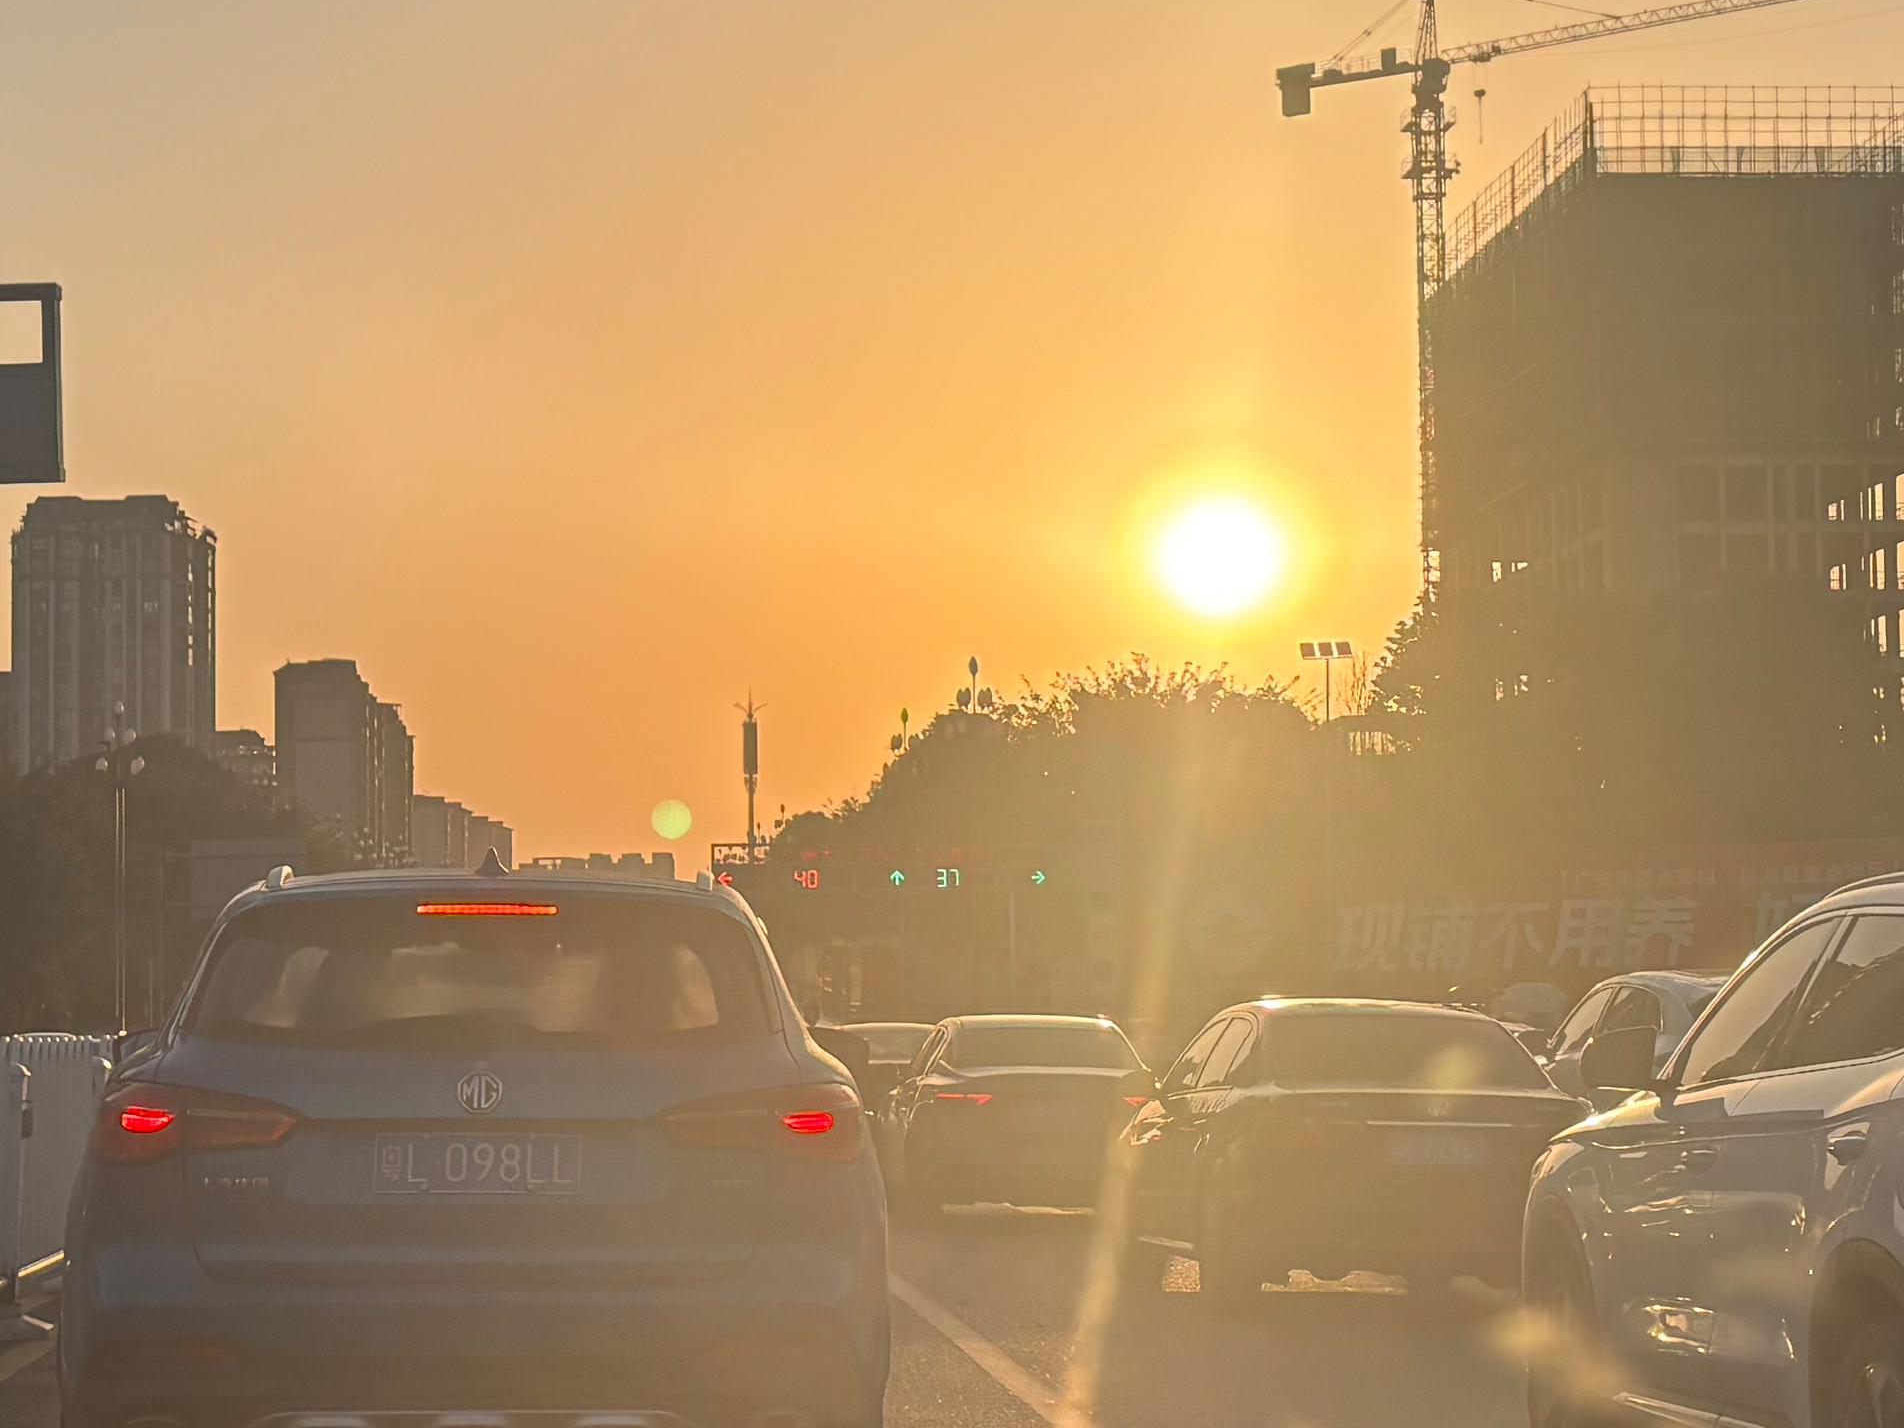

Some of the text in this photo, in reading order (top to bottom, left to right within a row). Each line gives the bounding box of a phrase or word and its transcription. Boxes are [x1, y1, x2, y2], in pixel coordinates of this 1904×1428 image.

[794, 869, 819, 888] 40
[936, 868, 960, 888] 37
[461, 1073, 500, 1110] MG
